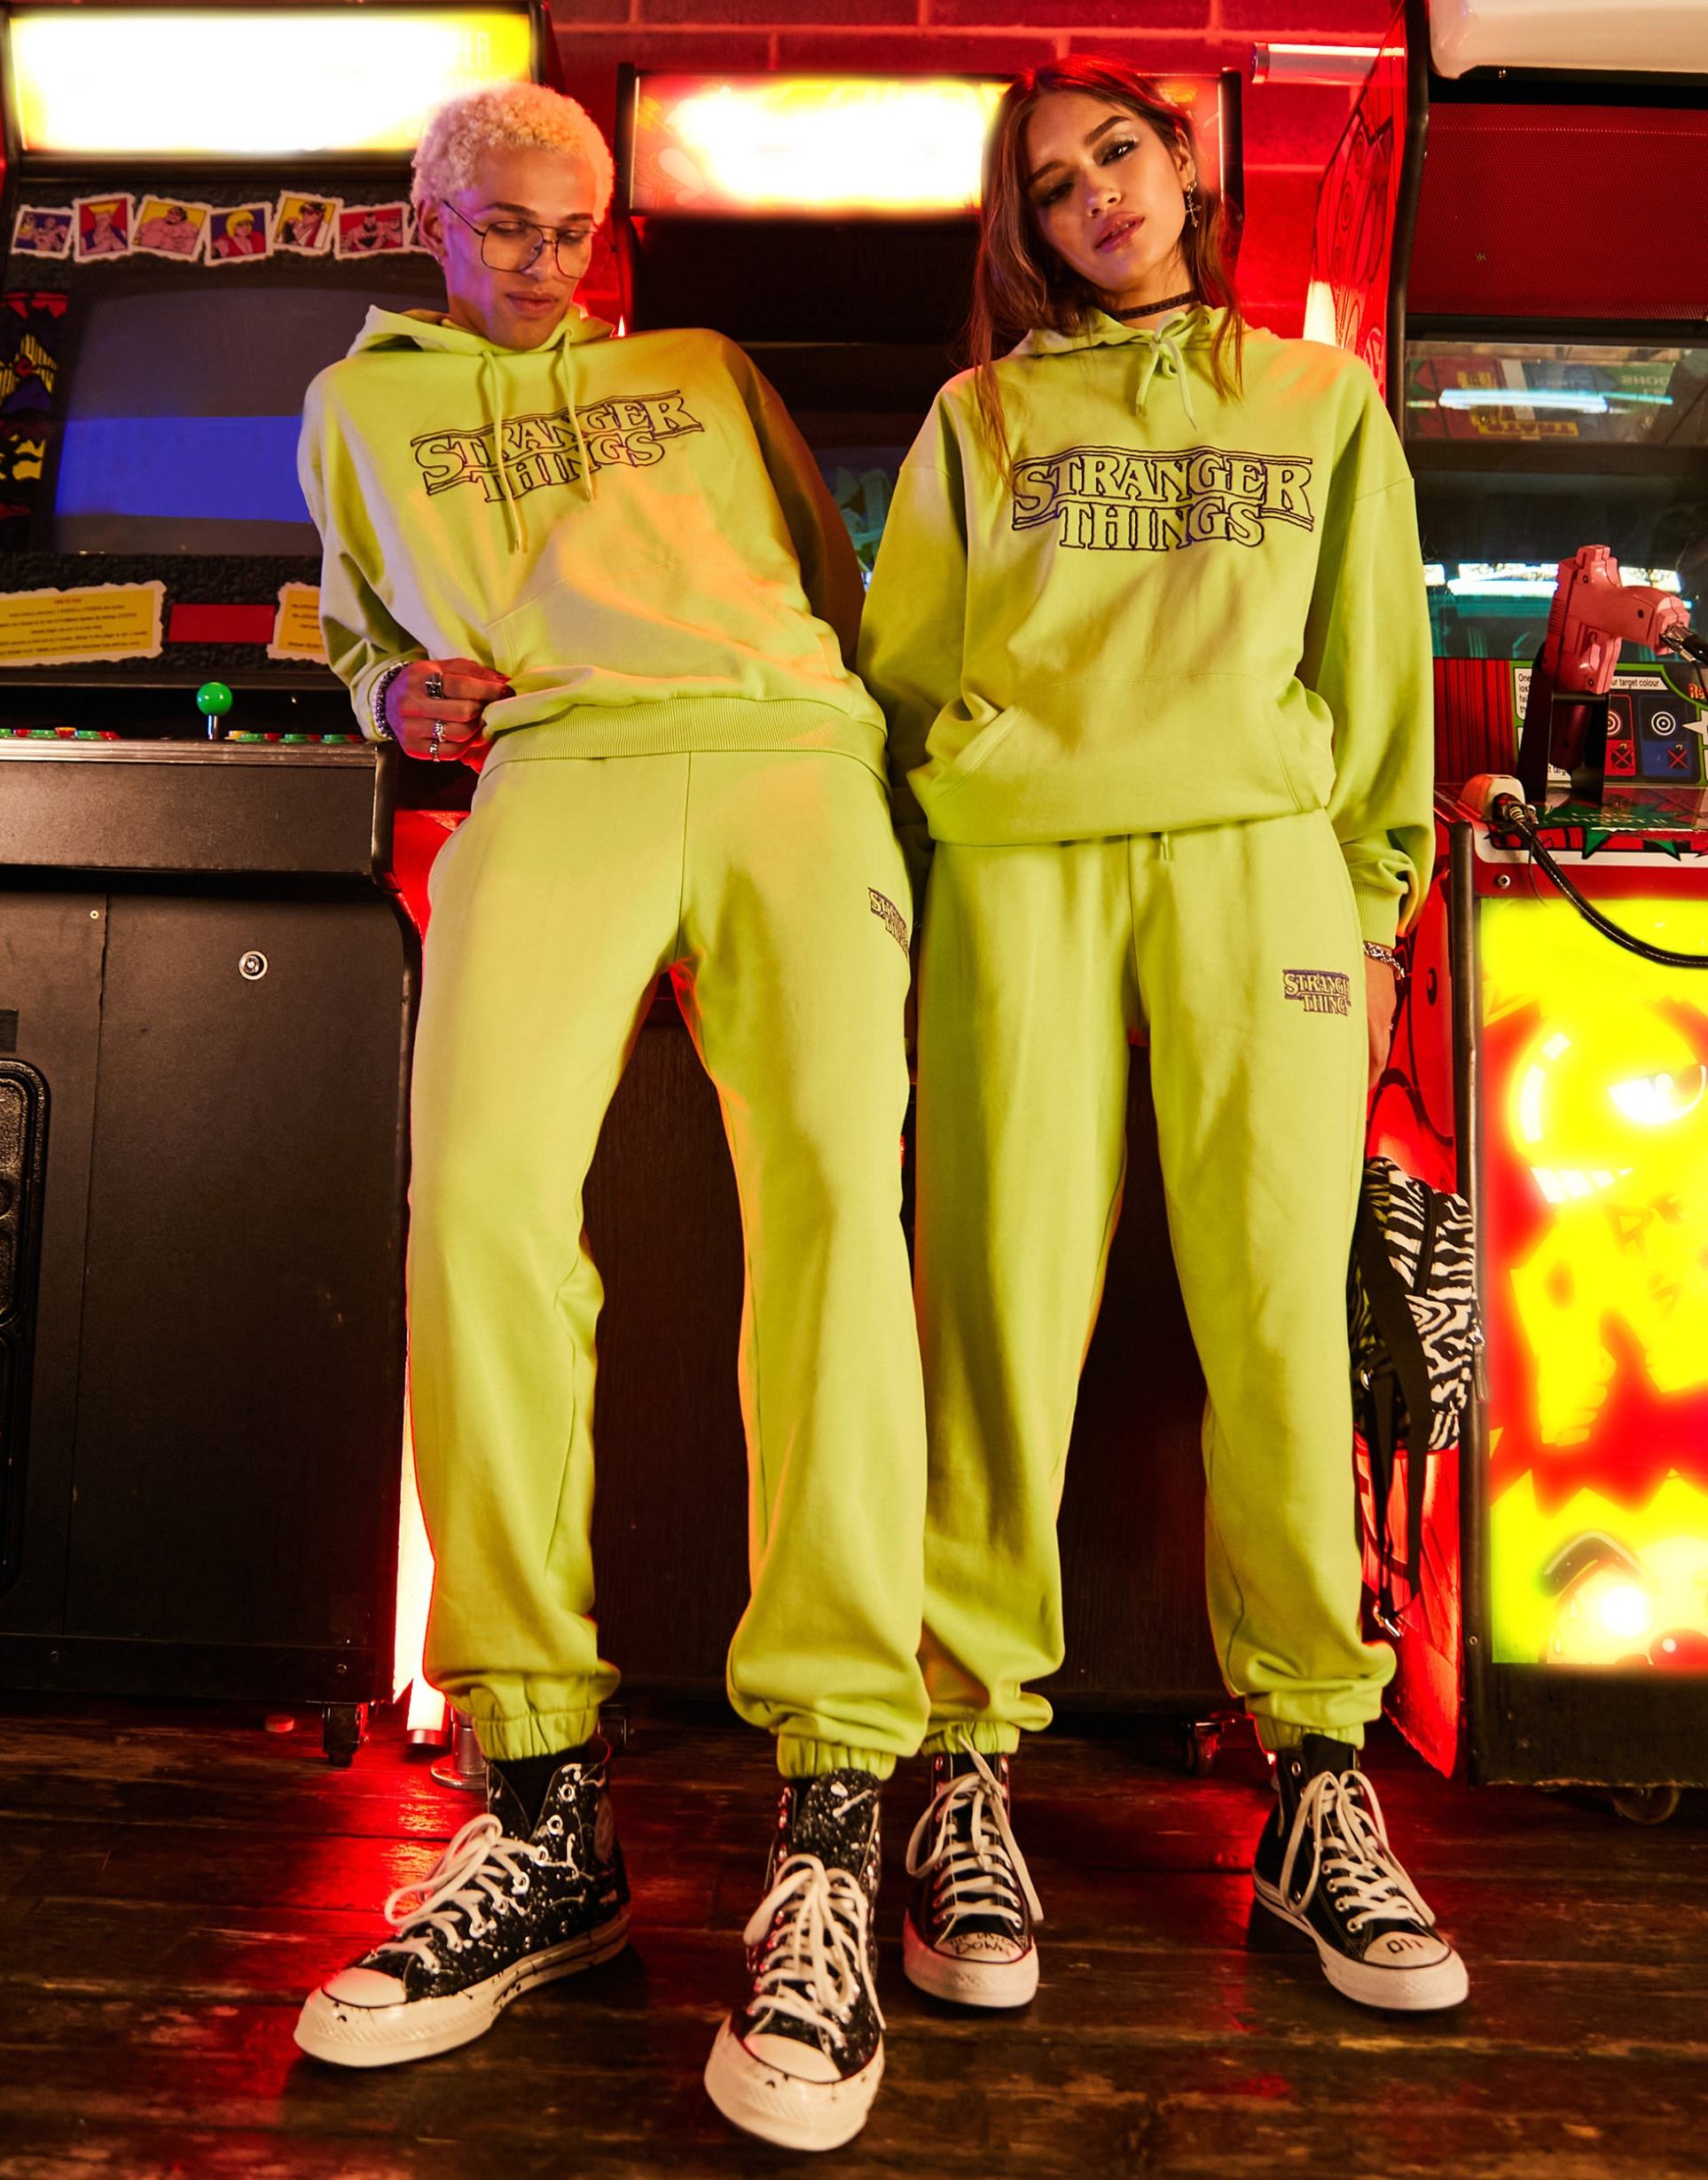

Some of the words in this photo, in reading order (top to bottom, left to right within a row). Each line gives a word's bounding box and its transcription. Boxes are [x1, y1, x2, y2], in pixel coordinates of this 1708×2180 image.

[411, 391, 703, 494] STRANGER
[470, 429, 665, 503] THINGS
[1012, 447, 1314, 529] STRANGER
[1060, 497, 1265, 552] THINGS
[1618, 678, 1638, 689] target
[1639, 678, 1659, 687] colour
[1282, 969, 1349, 997] STRANG
[1304, 992, 1349, 1016] THING
[955, 1941, 1011, 1957] DOWN
